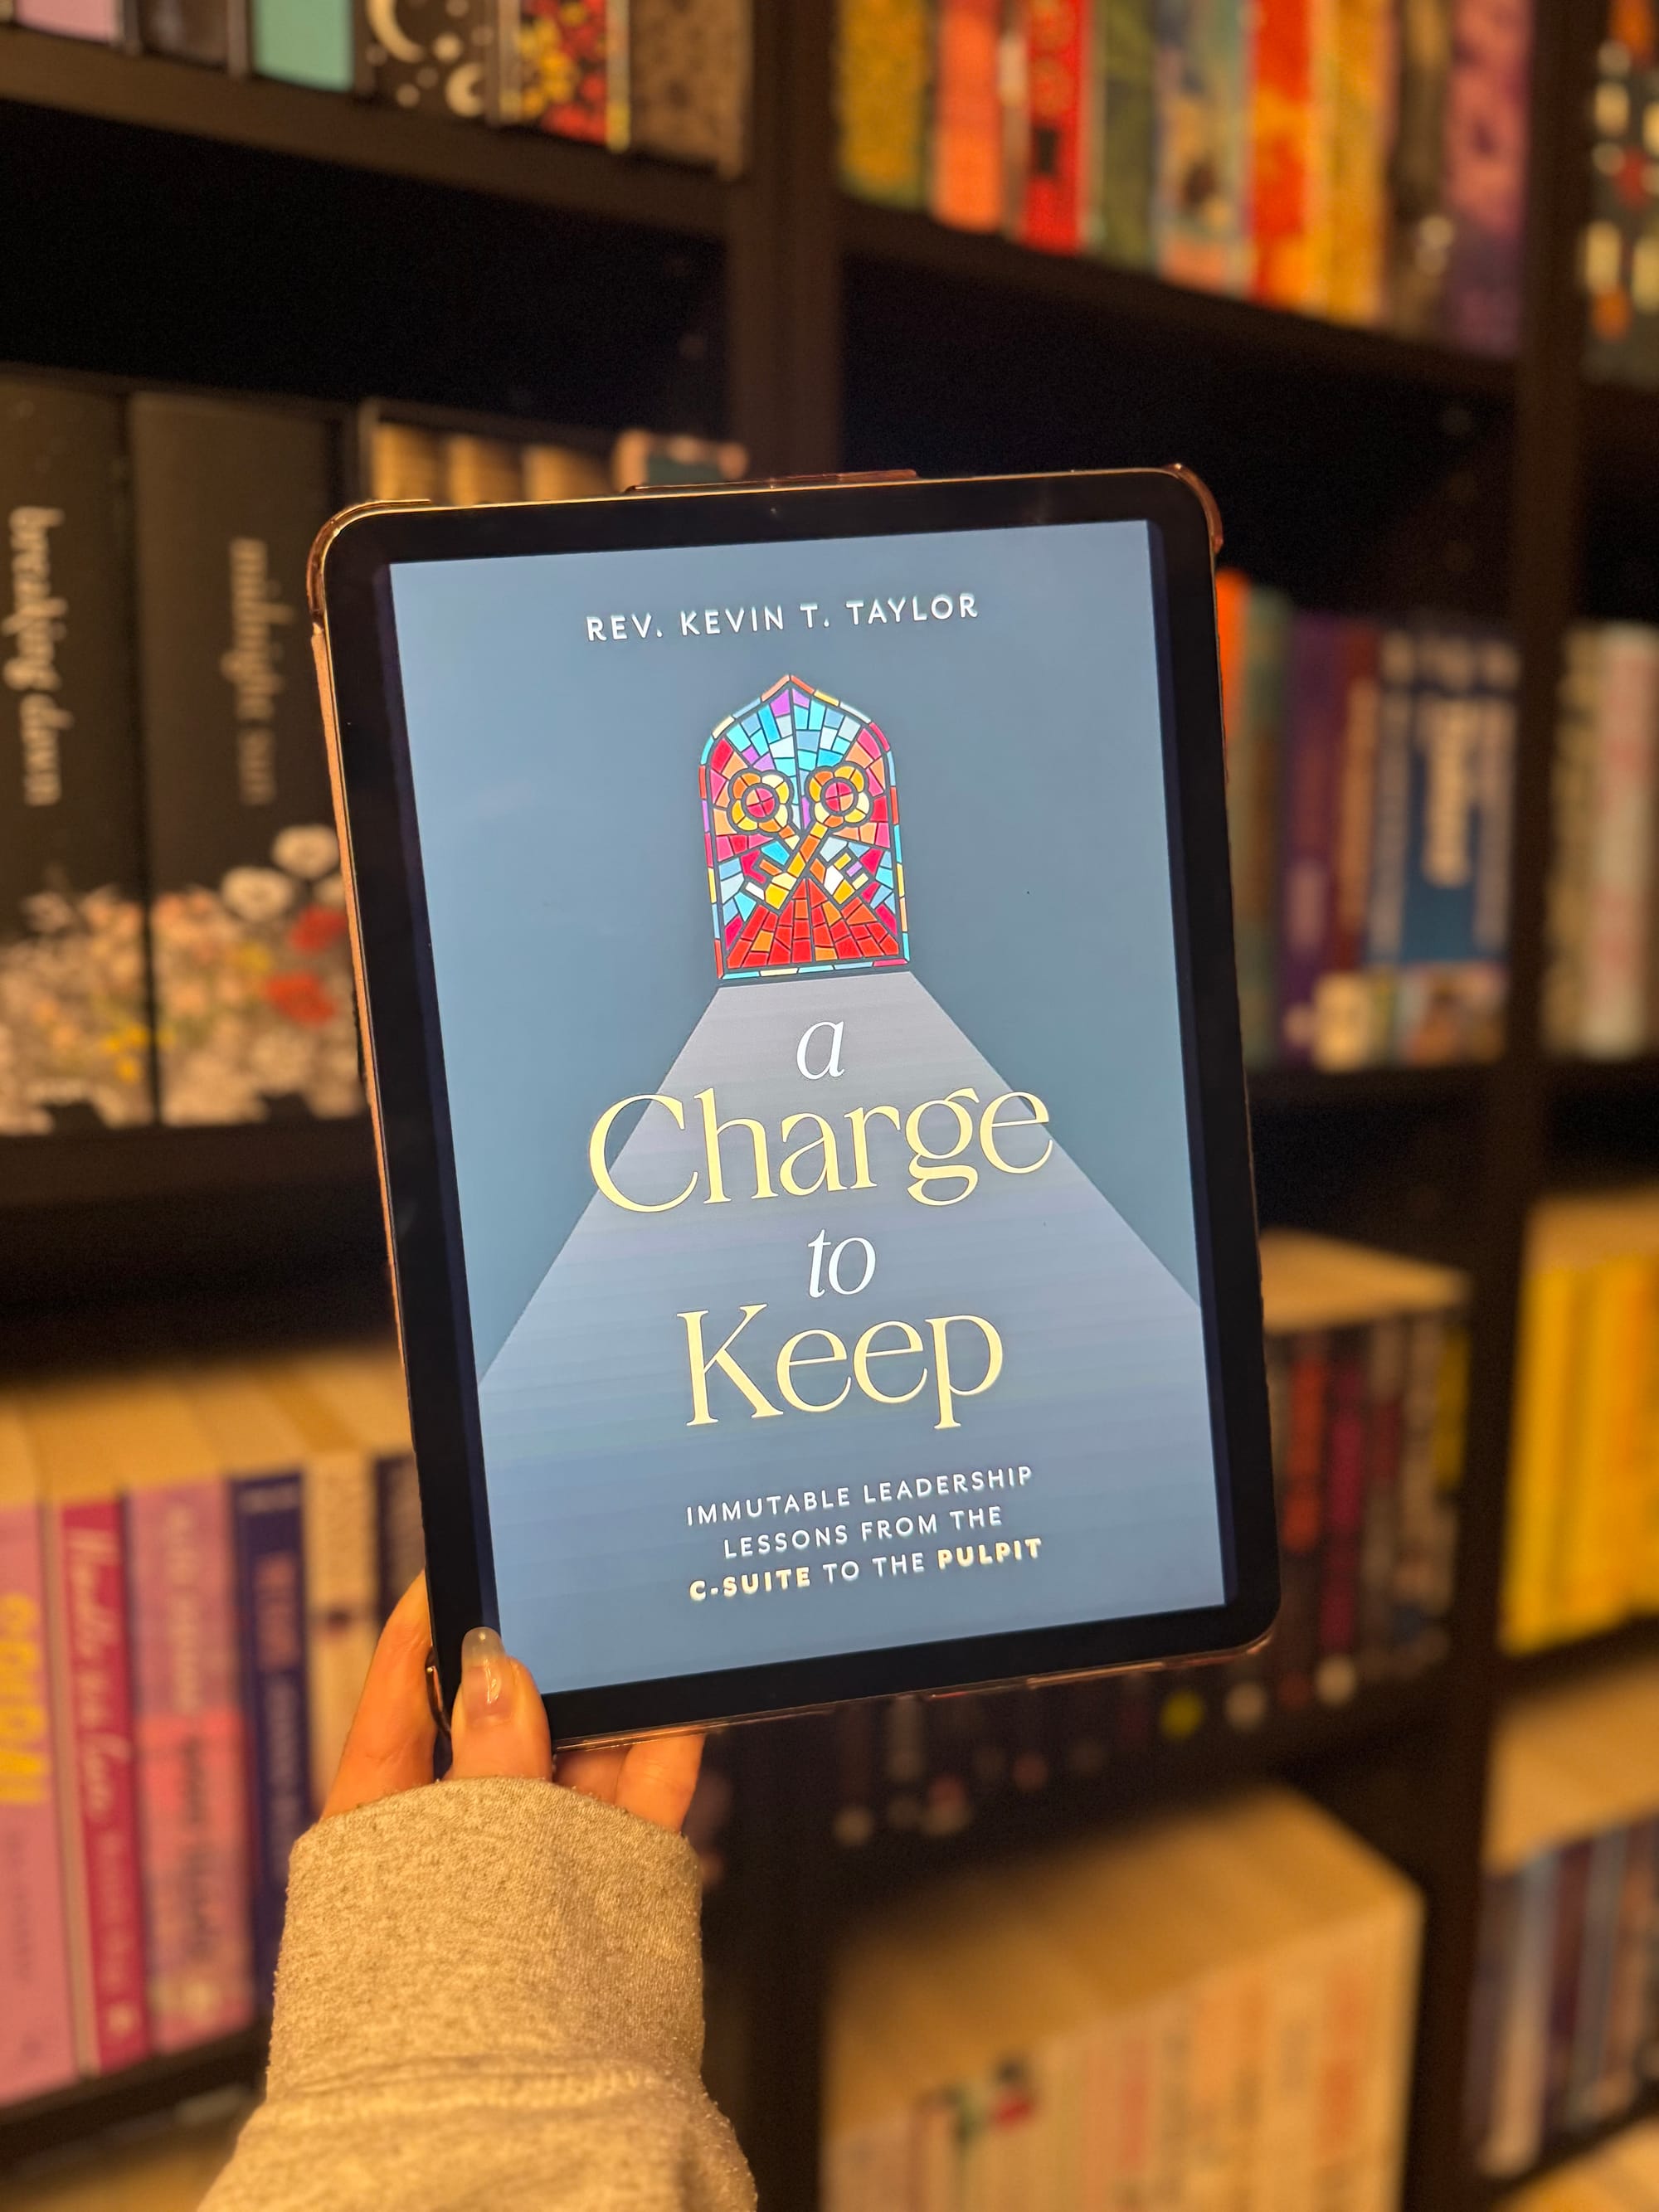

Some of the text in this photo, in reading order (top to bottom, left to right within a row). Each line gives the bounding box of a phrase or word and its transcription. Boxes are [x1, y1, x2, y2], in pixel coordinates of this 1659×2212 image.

[586, 592, 978, 642] REV. KEVIN T. TAYLOR
[796, 1019, 845, 1080] a
[589, 1087, 1053, 1213] Charge
[807, 1228, 877, 1298] to
[676, 1302, 1004, 1429] Keep
[687, 1465, 1033, 1526] IMMUTABLE LEADERSHIP
[723, 1505, 1003, 1559] LESSONS FROM THE
[689, 1536, 1043, 1602] C-SUITE TO THE PULPIT
